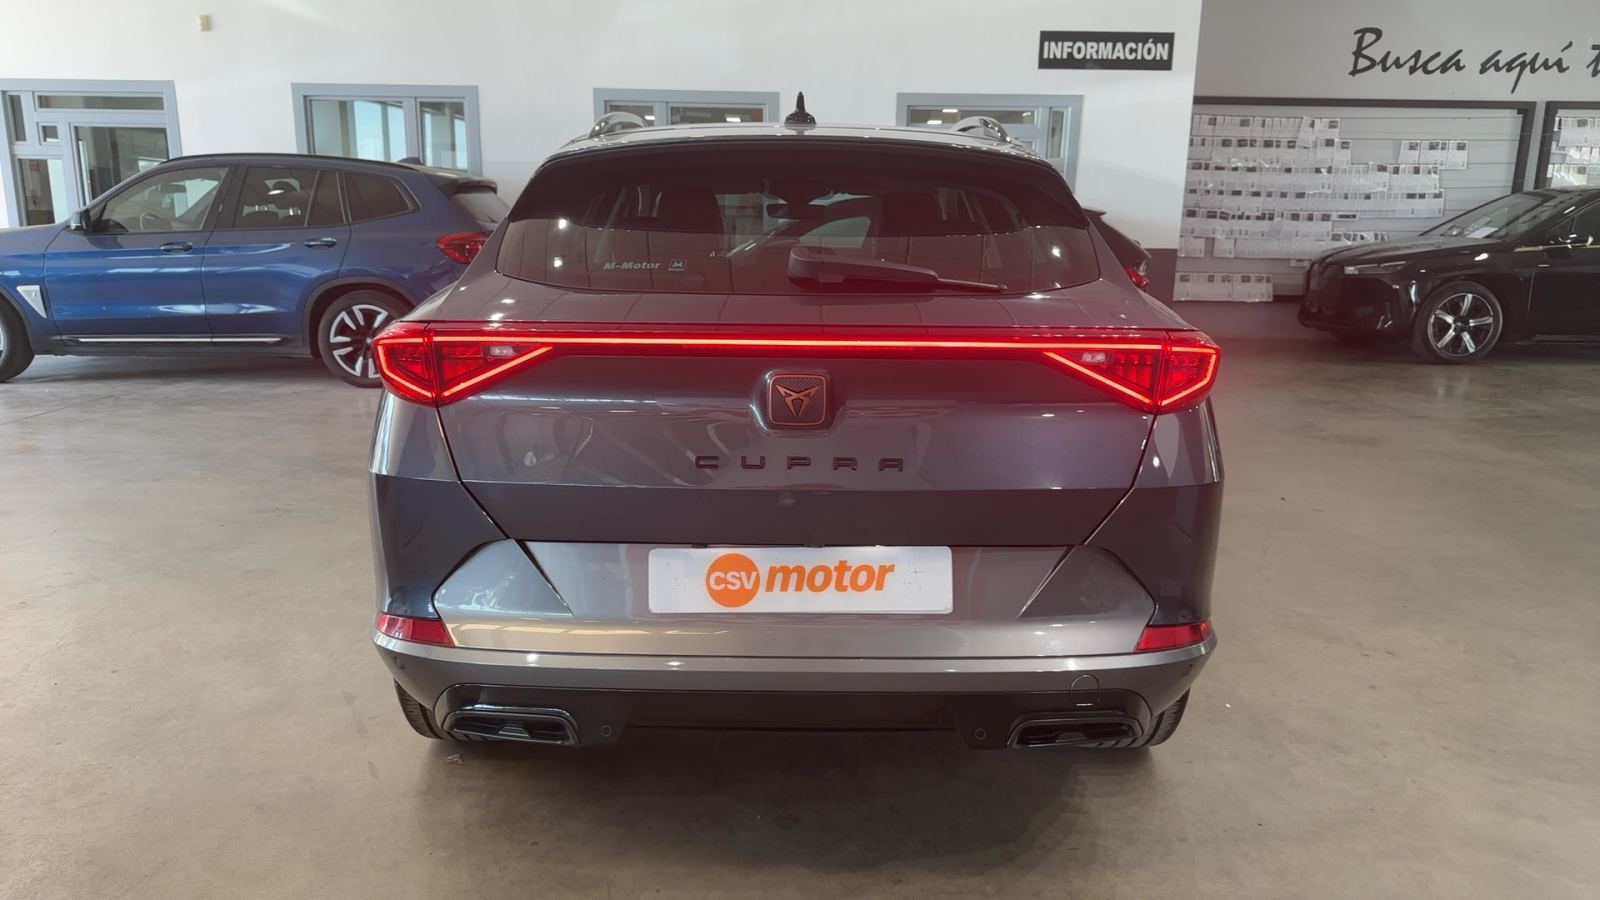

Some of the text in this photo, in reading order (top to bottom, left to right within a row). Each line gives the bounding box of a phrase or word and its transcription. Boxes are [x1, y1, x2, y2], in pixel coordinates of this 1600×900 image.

[1042, 38, 1169, 61] INFORMACIÓN
[1348, 26, 1466, 77] Busca
[1479, 40, 1573, 94] aquí
[603, 261, 662, 271] M-Motor
[695, 455, 904, 472] CUPRA
[764, 560, 895, 593] motor
